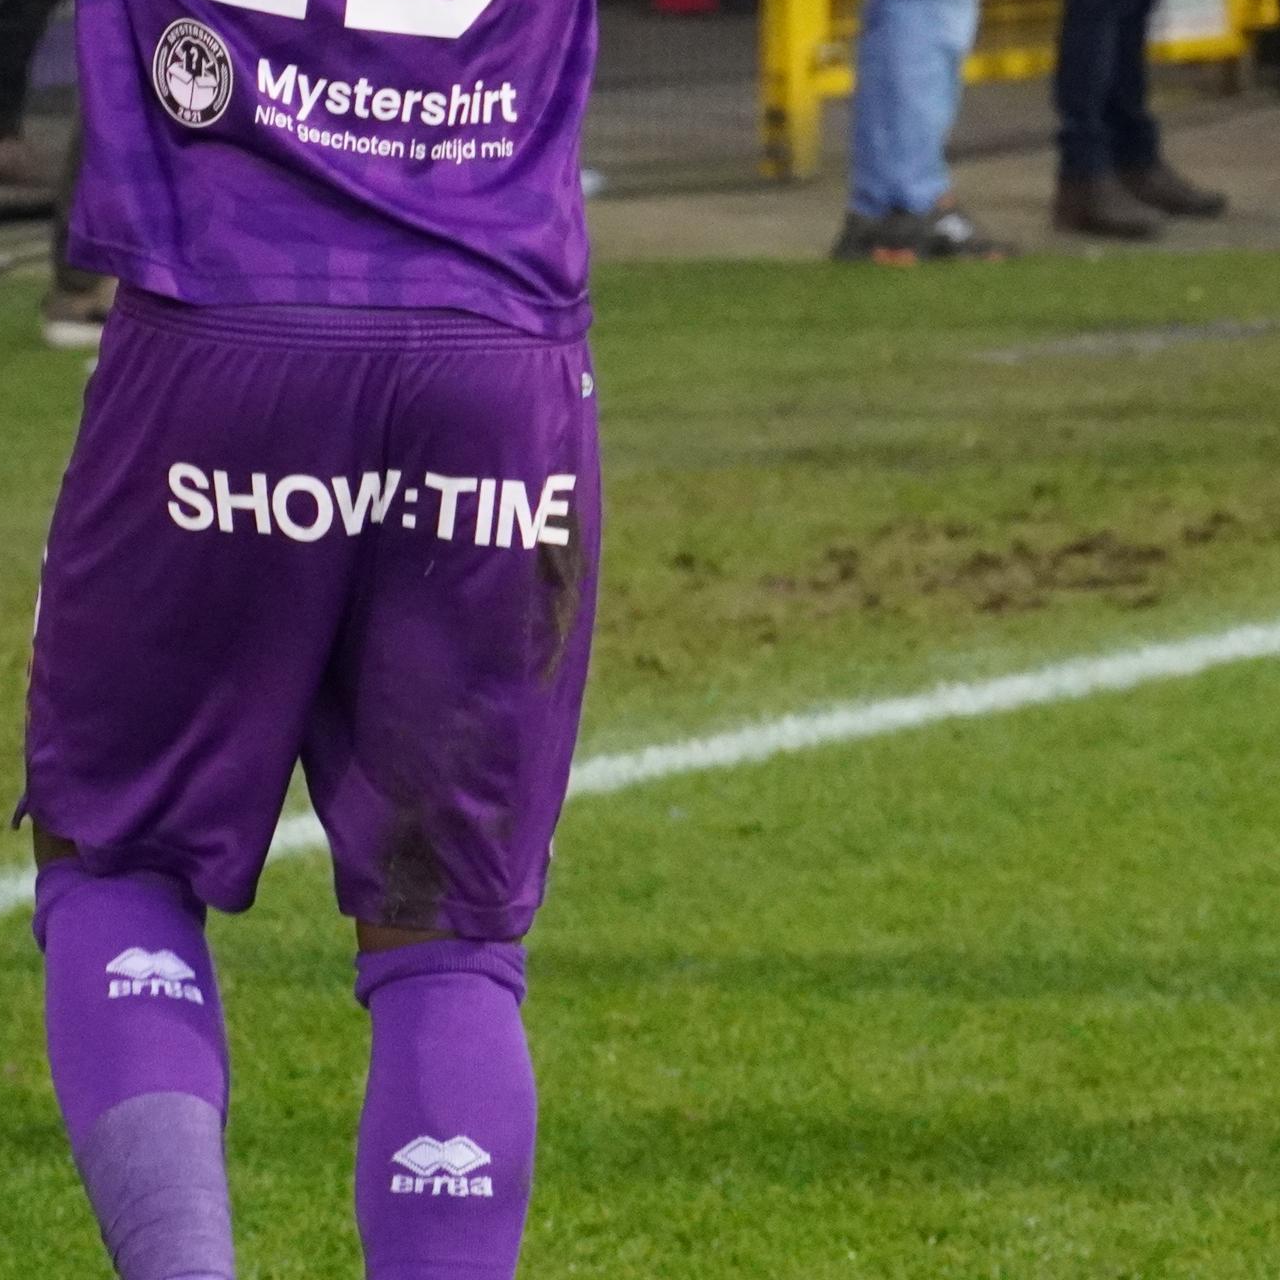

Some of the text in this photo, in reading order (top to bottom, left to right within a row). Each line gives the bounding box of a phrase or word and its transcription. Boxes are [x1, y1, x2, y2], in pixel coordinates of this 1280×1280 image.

[256, 58, 518, 127] Mystershirt
[296, 122, 404, 159] geschoten
[409, 138, 426, 160] is
[431, 138, 476, 165] altijd
[481, 136, 514, 159] mis
